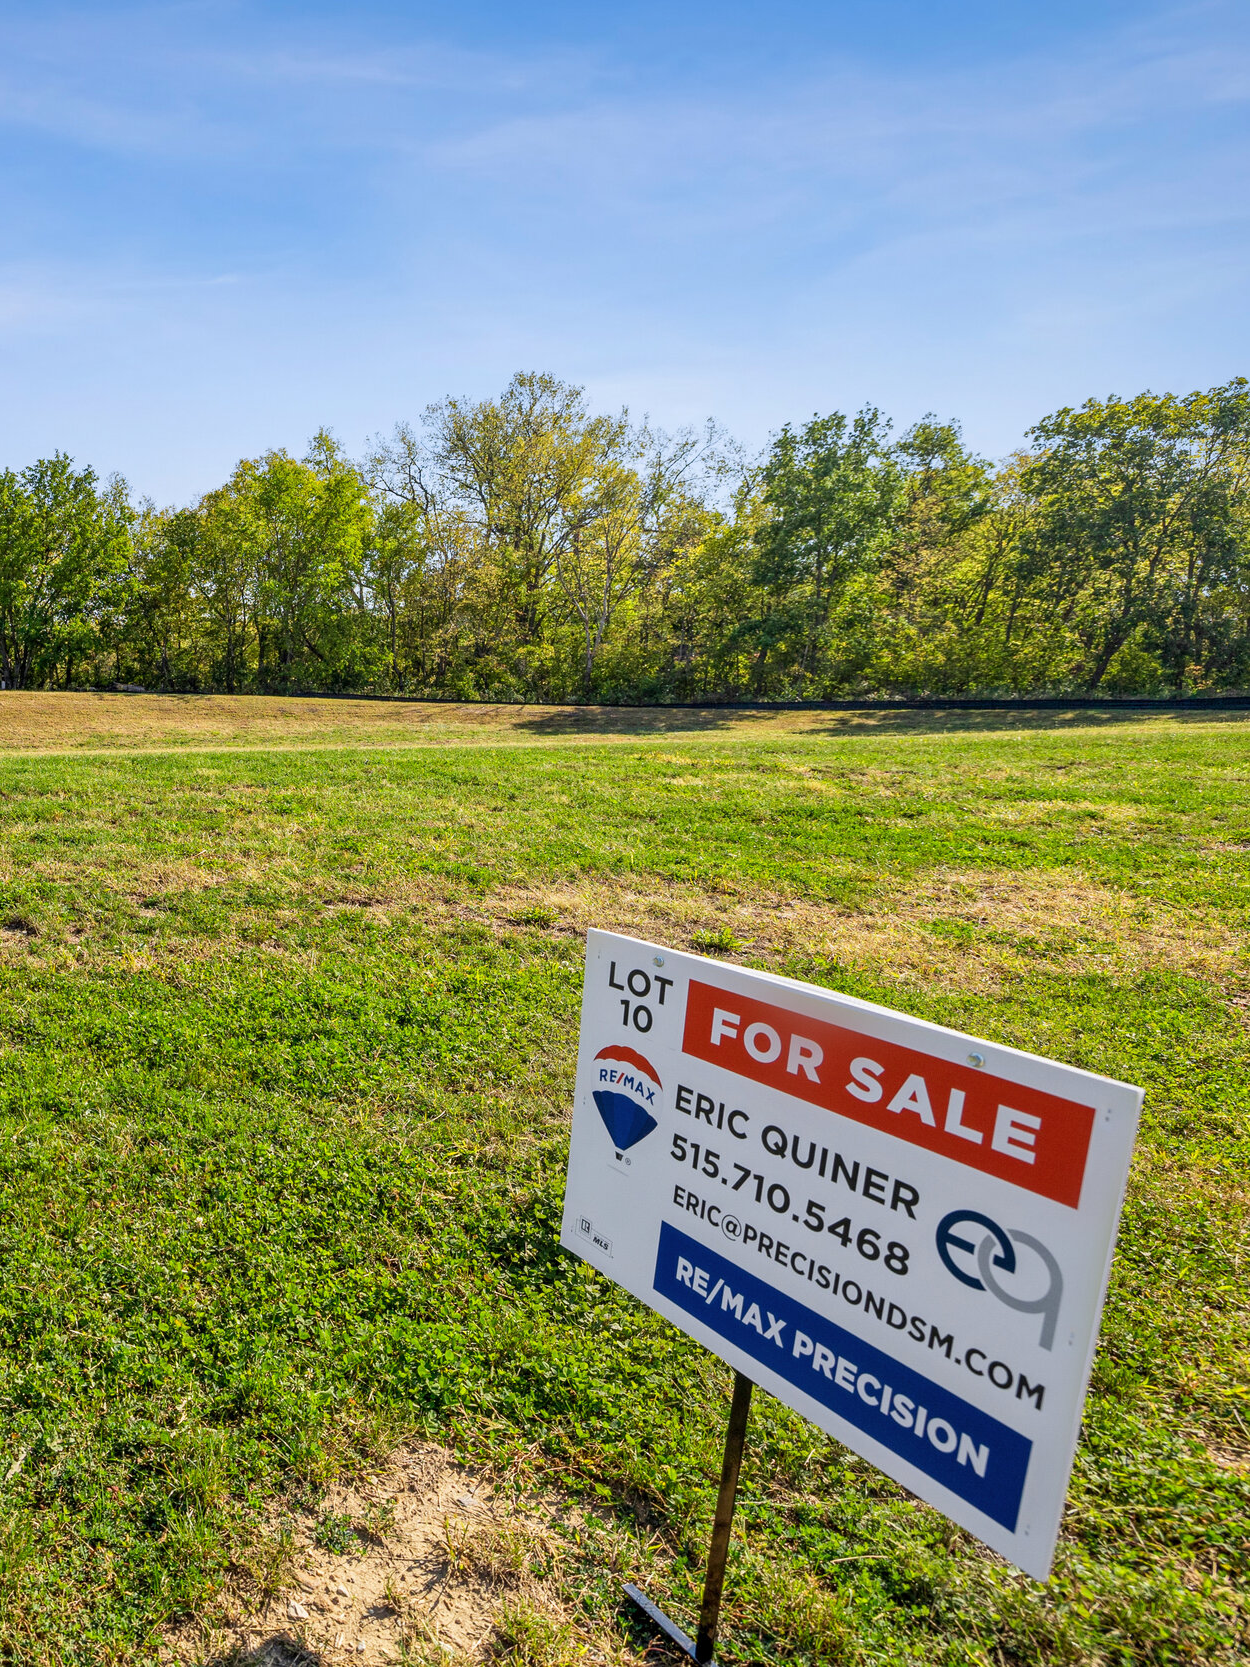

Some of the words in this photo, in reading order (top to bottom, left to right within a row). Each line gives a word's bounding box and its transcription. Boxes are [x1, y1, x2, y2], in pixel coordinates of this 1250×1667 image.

[608, 960, 674, 1006] LOT
[620, 999, 653, 1034] 10
[599, 1068, 655, 1106] RE/MAX
[674, 1084, 751, 1142] ERIC
[760, 1123, 921, 1221] QUINER
[709, 1006, 825, 1084] FOR
[844, 1055, 1043, 1166] SALE
[592, 1236, 610, 1251] MLS
[669, 1133, 911, 1277] 515.710.5468
[672, 1184, 1046, 1412] ERIC@PRECISIONDSM.COM
[675, 1255, 787, 1347] RE/MAX
[791, 1330, 990, 1478] PRECISION
